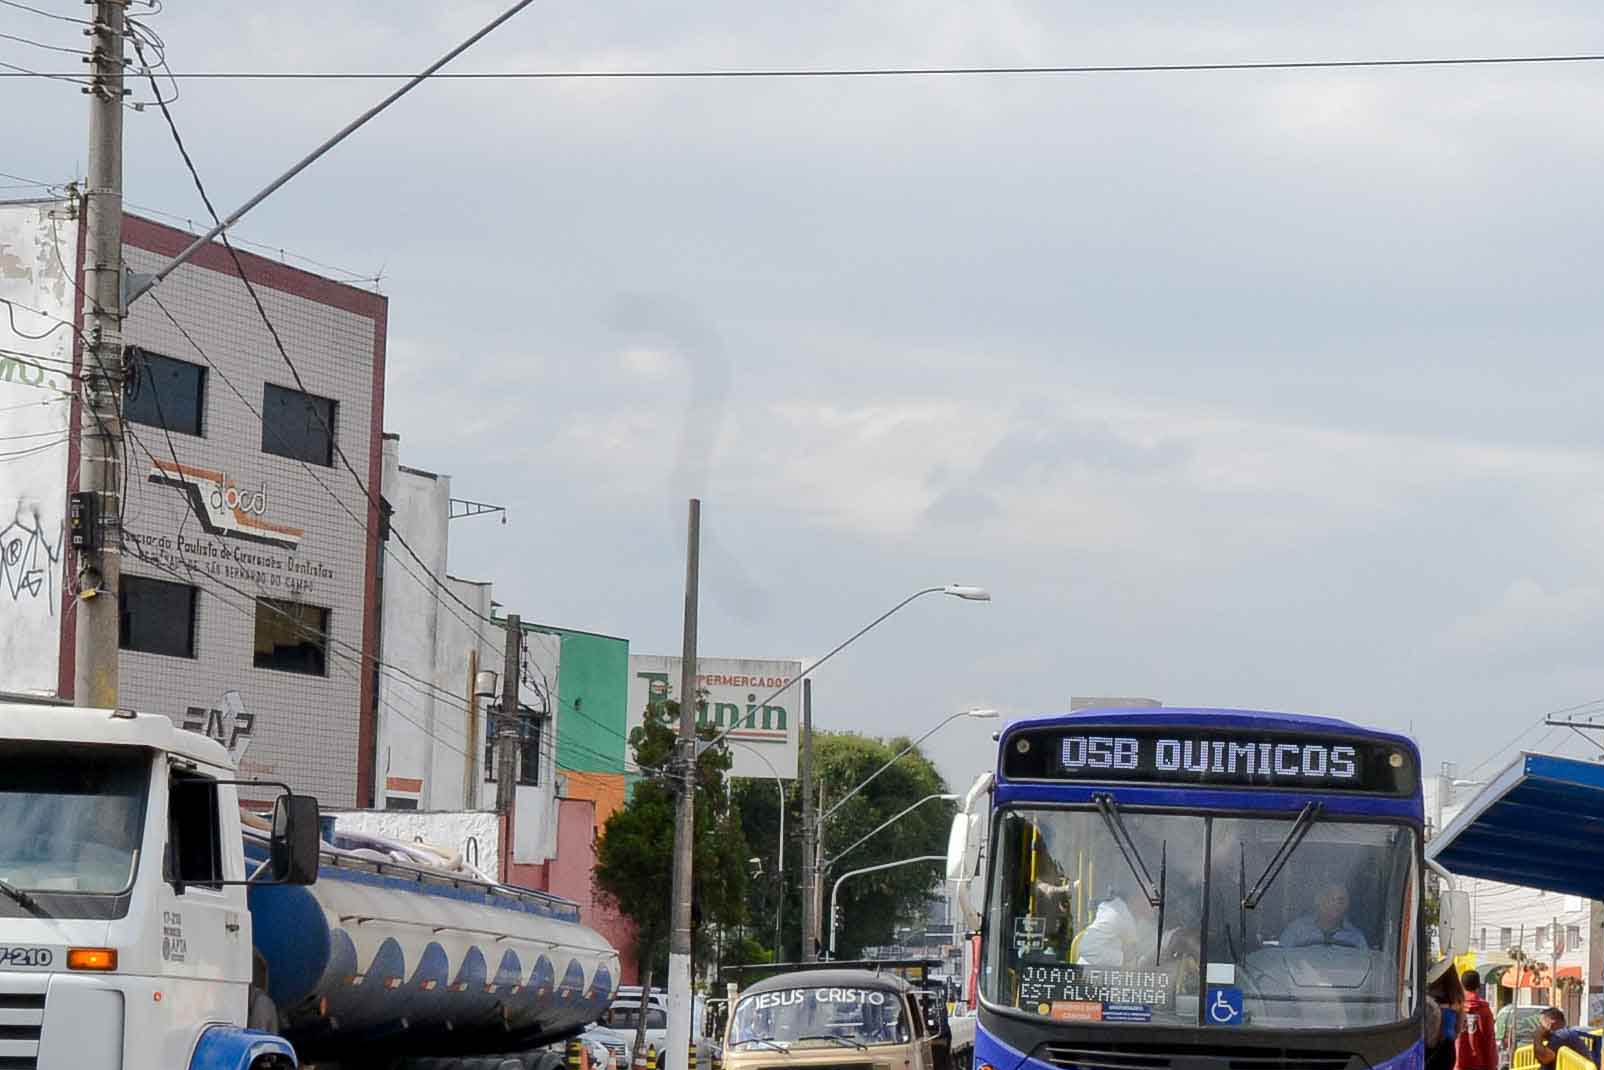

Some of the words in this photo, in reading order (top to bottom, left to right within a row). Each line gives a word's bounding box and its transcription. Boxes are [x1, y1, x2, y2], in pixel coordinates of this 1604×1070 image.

[1155, 739, 1356, 777] QUIMICOS
[1022, 966, 1076, 984] JOAO
[753, 989, 805, 1010] JESUS
[815, 987, 885, 1006] CRISTO
[1021, 983, 1056, 999] EST
[1063, 985, 1167, 1005] ALVARENGA
